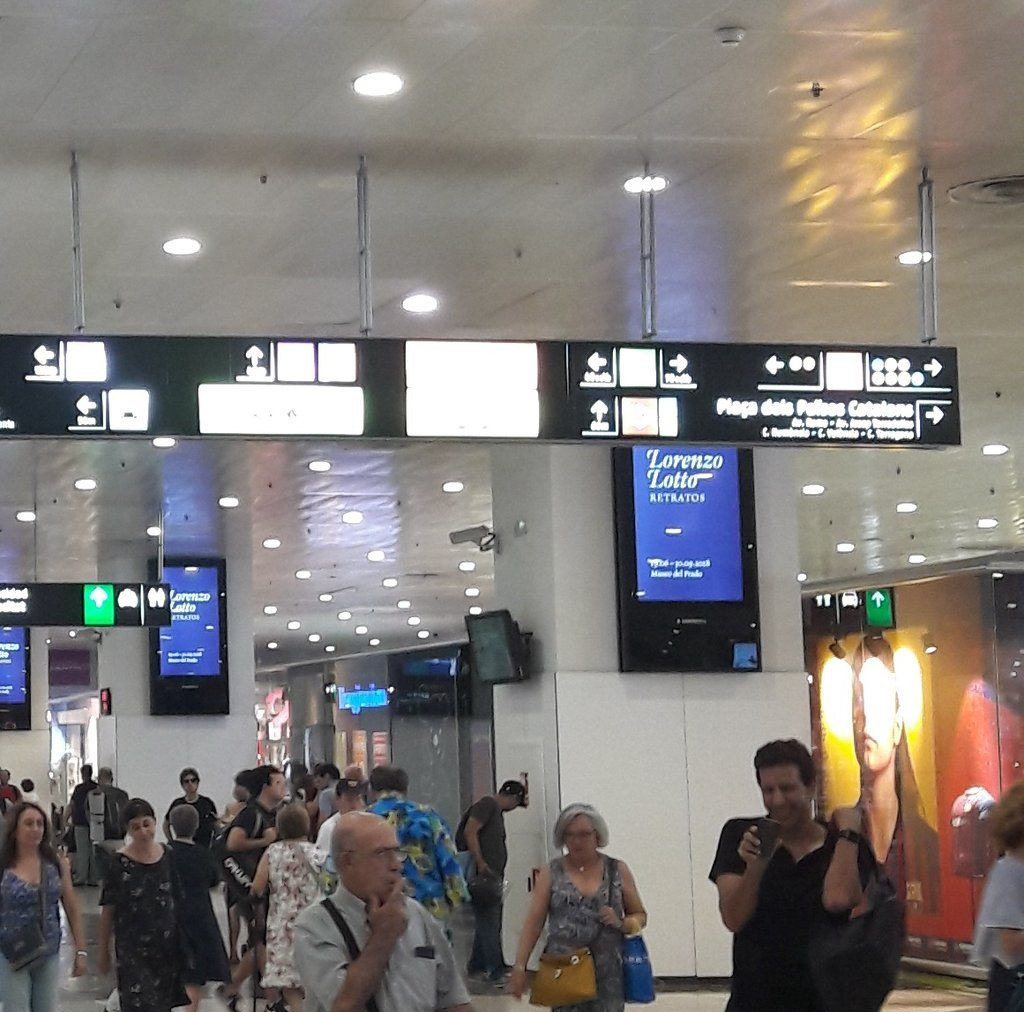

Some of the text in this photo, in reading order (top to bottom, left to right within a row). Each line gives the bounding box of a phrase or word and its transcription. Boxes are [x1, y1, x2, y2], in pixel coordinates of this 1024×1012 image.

[646, 448, 724, 469] Lorenzo
[646, 468, 699, 489] Lotto
[649, 492, 706, 503] RETRATOS
